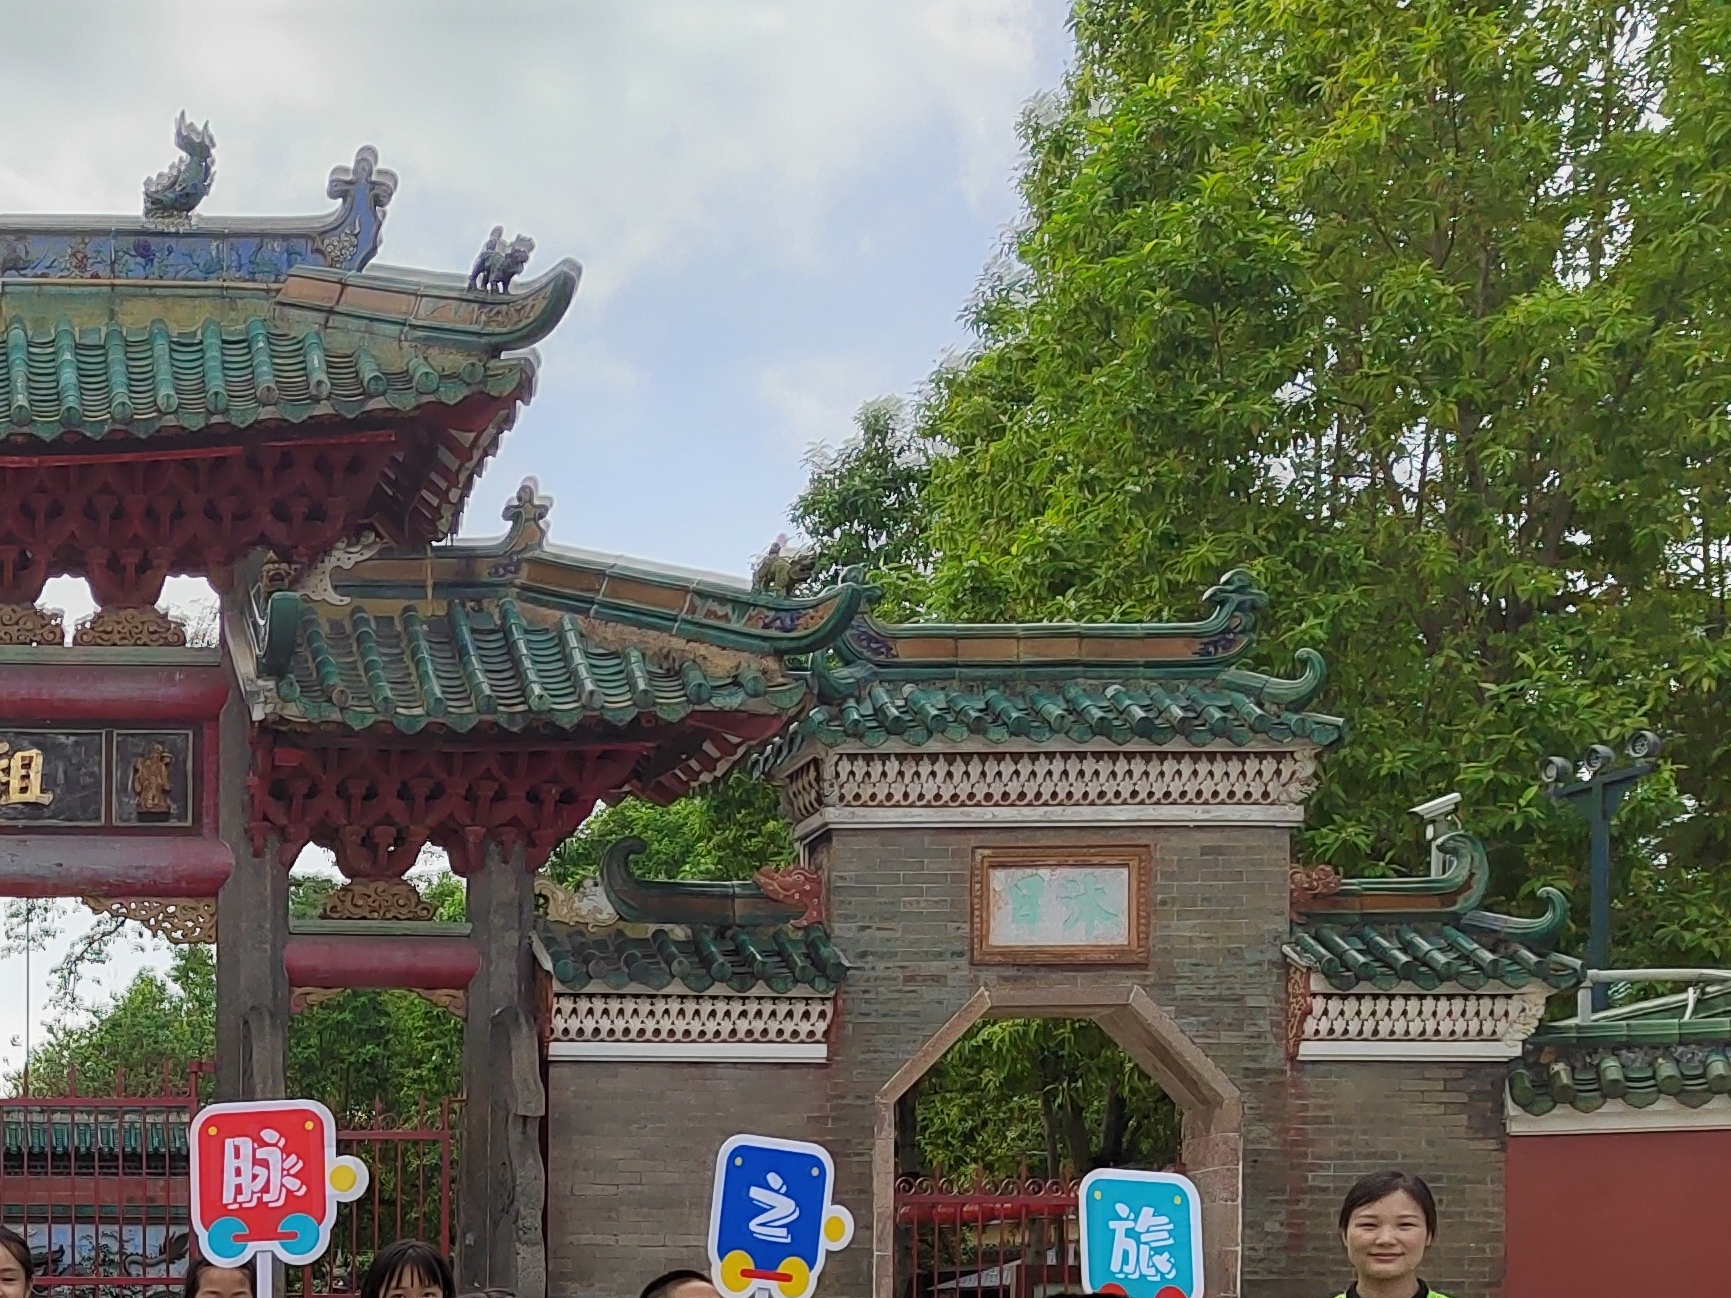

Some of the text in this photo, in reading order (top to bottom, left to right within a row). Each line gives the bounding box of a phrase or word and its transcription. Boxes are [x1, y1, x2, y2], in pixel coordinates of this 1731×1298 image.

[222, 1128, 307, 1210] 脉
[748, 1172, 800, 1243] 之
[1109, 1203, 1177, 1281] 旅
